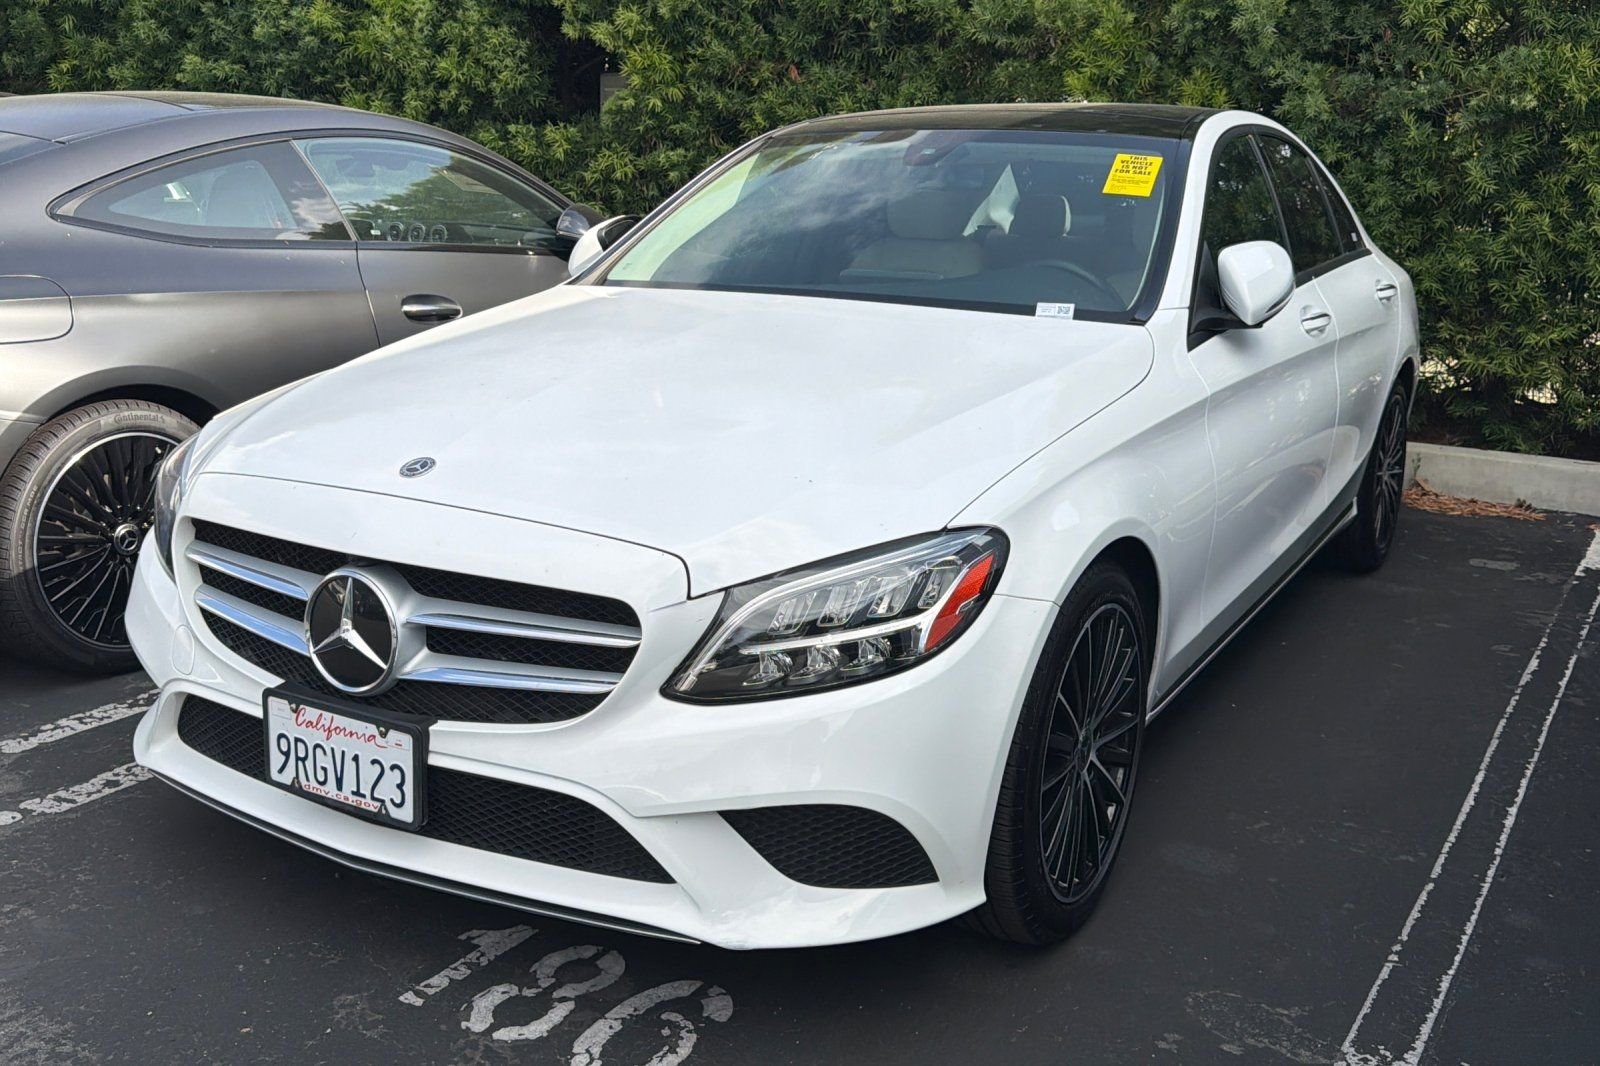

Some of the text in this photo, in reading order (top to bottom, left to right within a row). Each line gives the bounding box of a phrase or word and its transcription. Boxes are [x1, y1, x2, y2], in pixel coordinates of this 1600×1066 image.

[113, 412, 159, 425] Continental
[295, 706, 388, 749] California
[276, 732, 407, 809] 9RGV123
[303, 783, 380, 811] dmv.ca.gov
